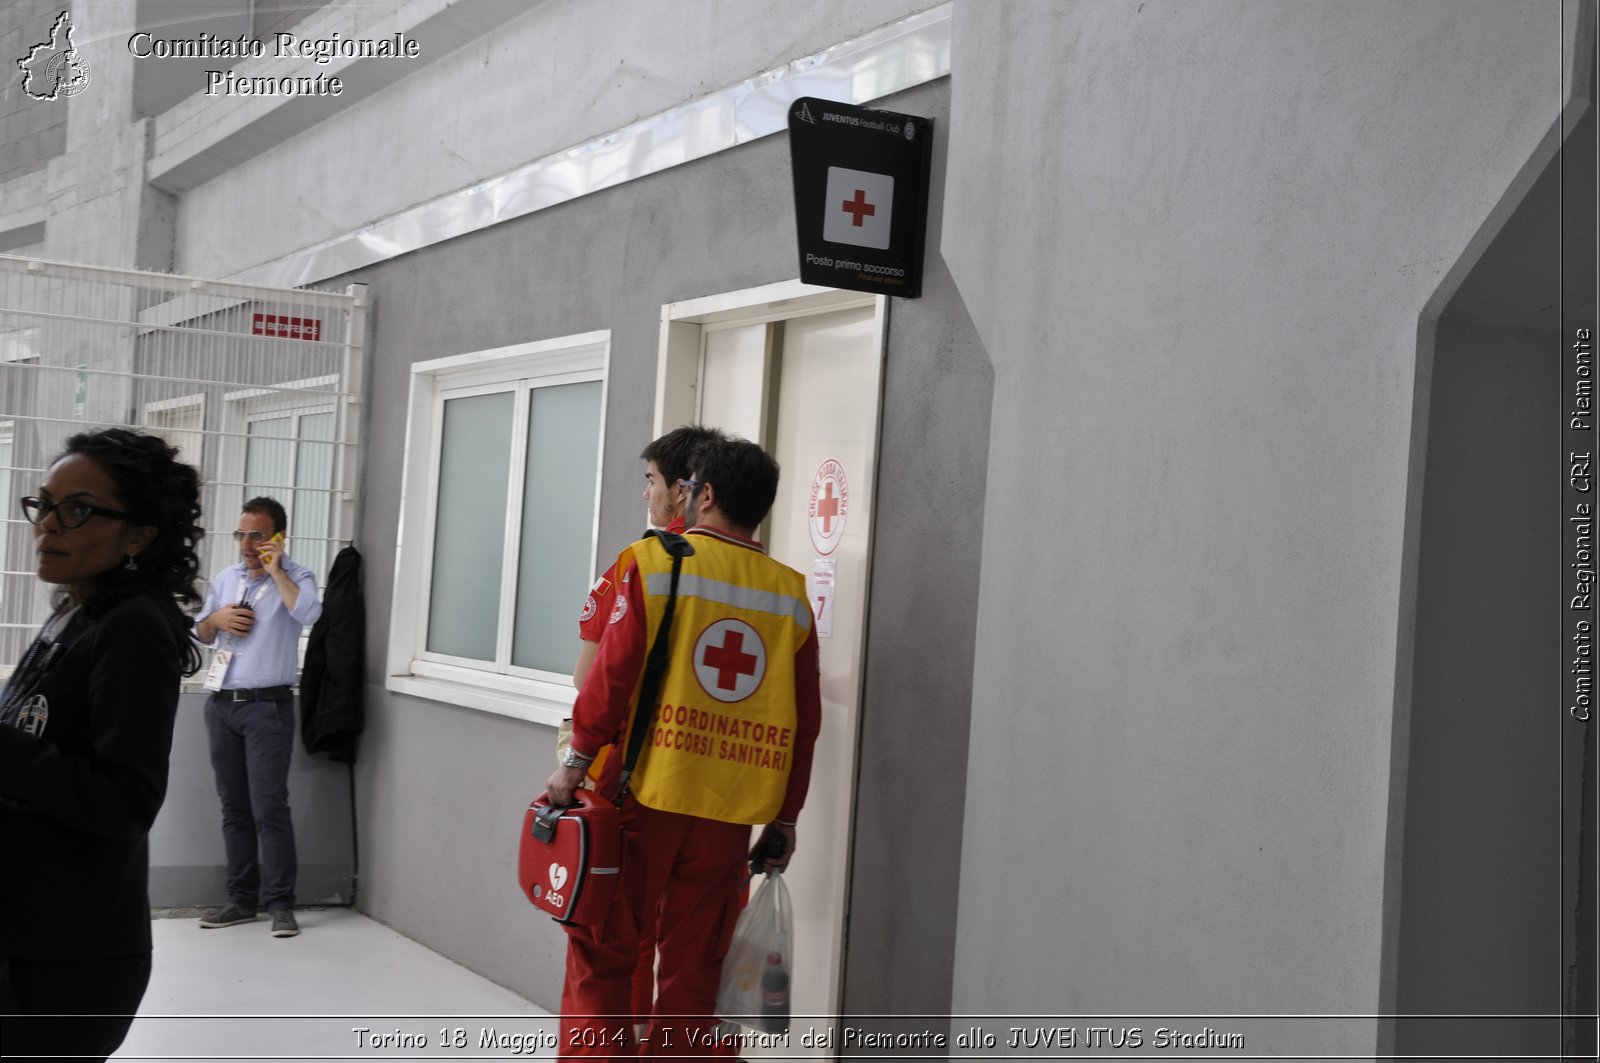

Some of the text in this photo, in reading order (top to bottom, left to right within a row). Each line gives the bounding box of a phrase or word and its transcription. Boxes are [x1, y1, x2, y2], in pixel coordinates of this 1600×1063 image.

[822, 112, 901, 134] JUVENTUS Football Club
[806, 253, 905, 277] Posto primo soccorso
[817, 596, 826, 621] 7
[653, 703, 791, 748] COORDINATORE
[648, 727, 788, 771] SOCCORSI SANITARI
[545, 889, 564, 908] AED
